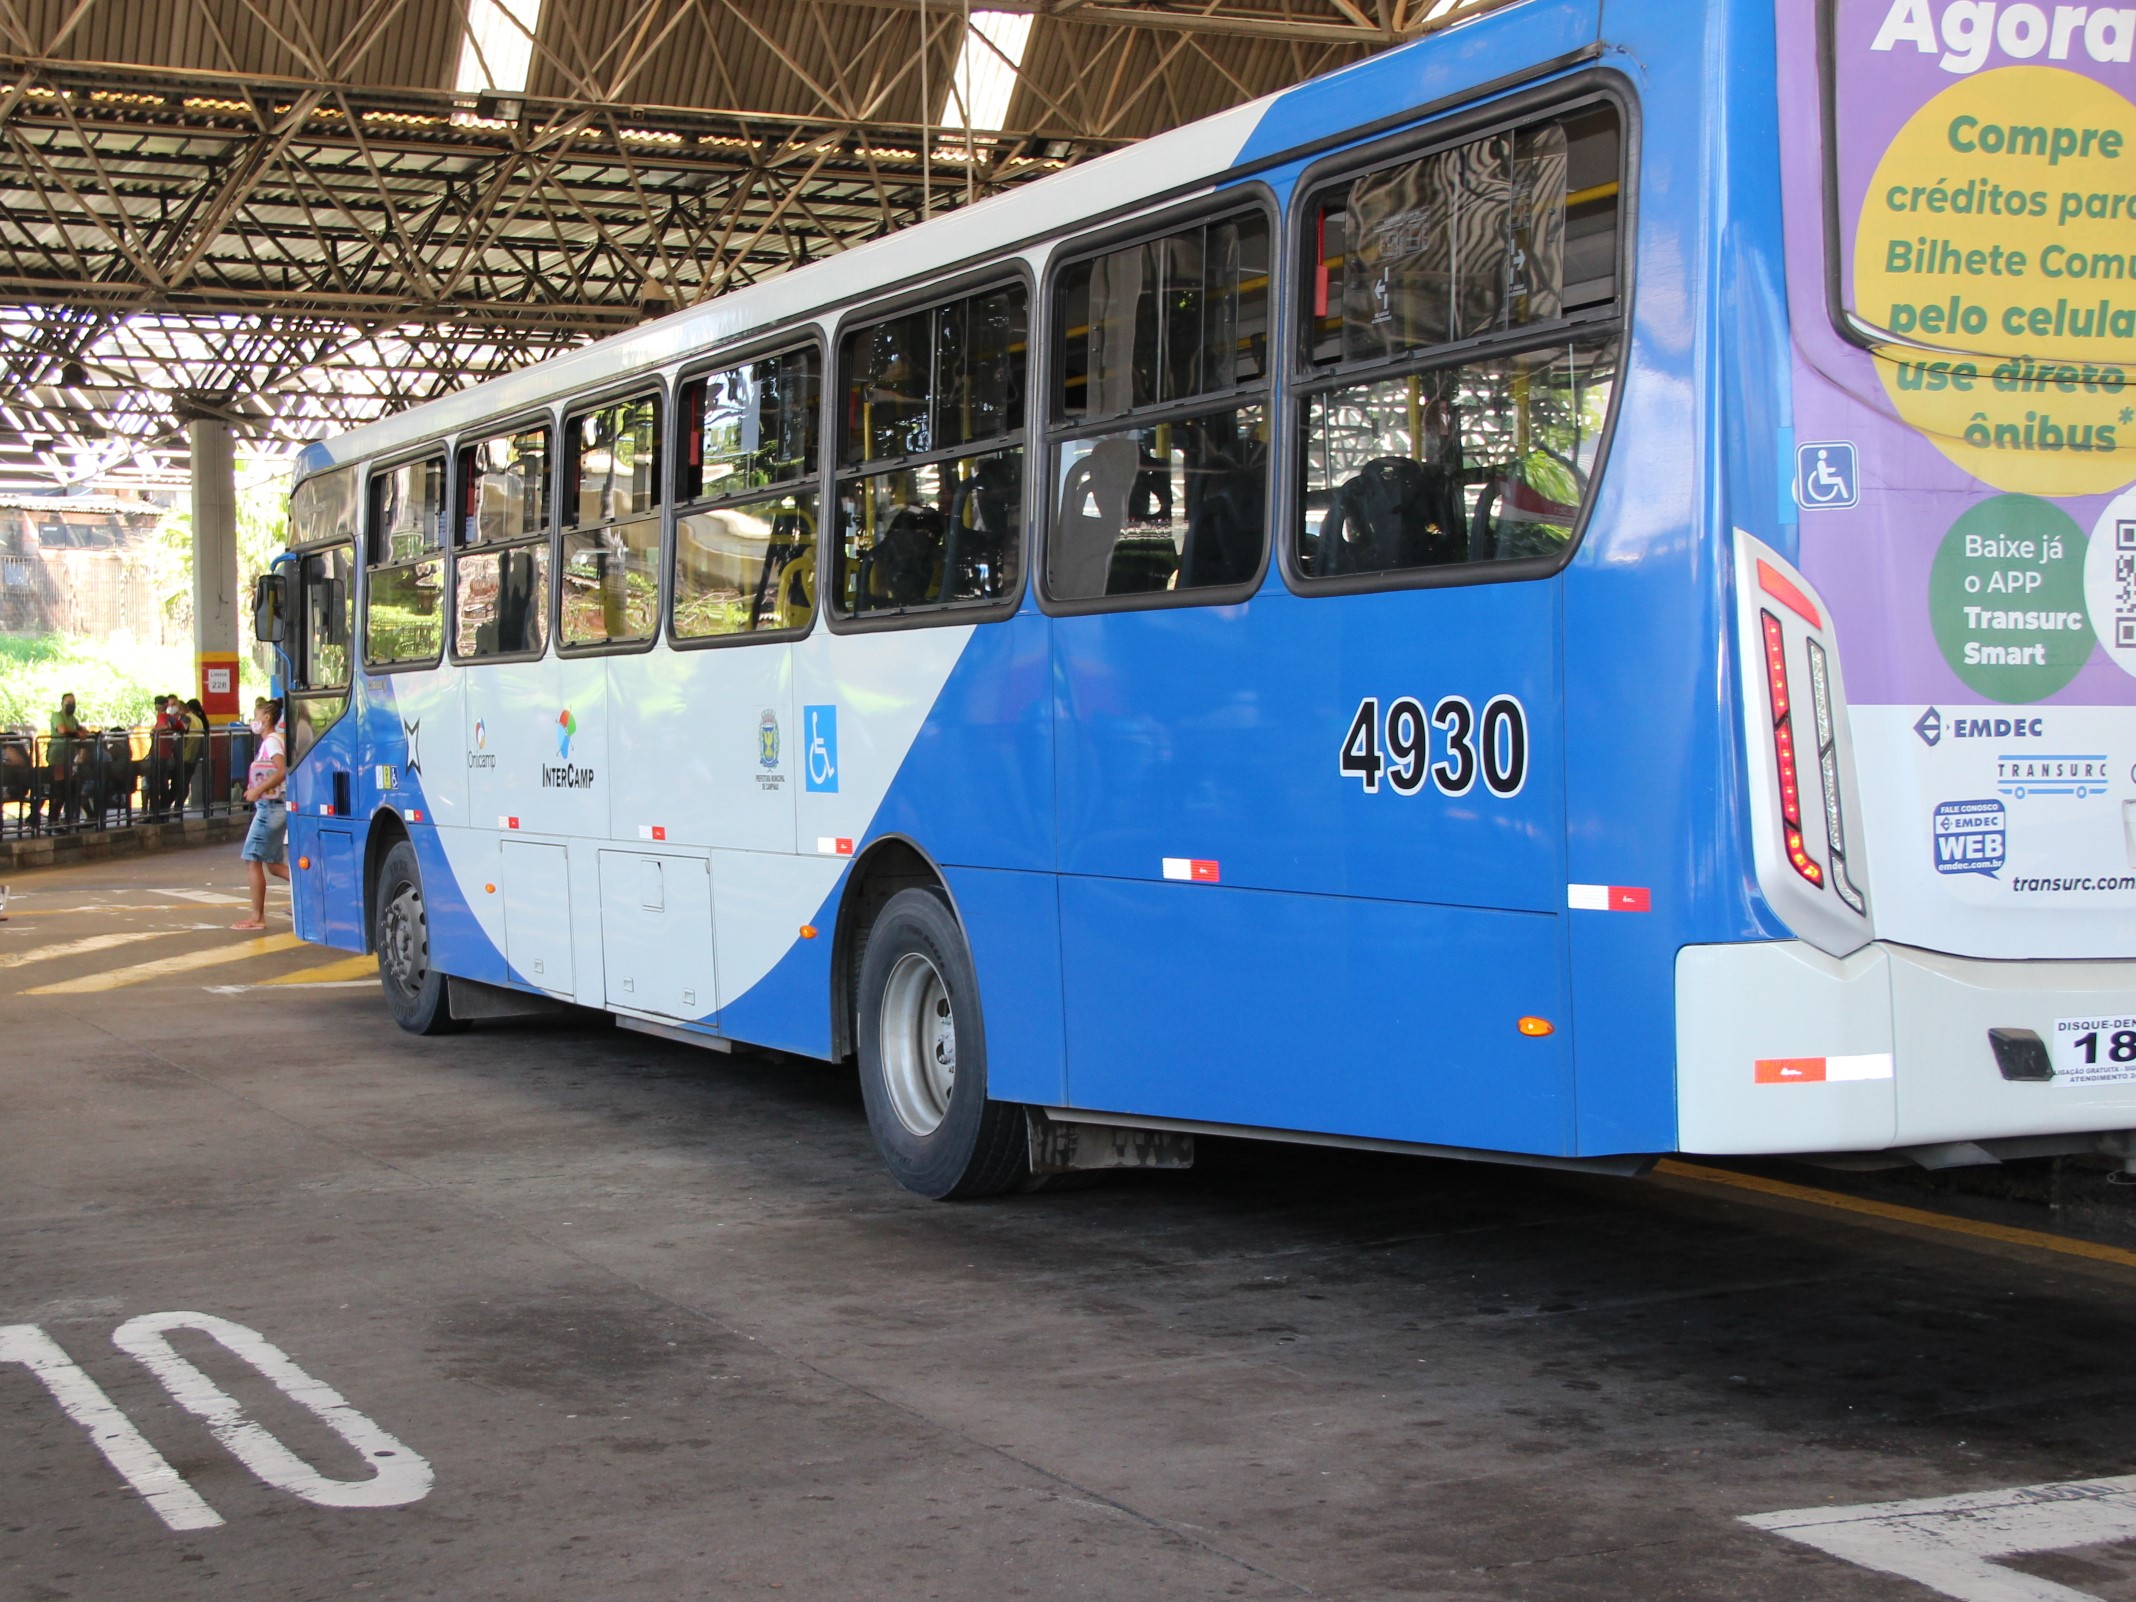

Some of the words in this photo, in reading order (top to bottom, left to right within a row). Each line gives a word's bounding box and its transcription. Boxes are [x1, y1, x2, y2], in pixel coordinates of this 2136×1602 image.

[1870, 0, 2136, 74] Agora
[1948, 115, 2123, 166] Compre
[1886, 177, 2047, 217] créditos
[1885, 236, 2027, 276] Bilhete
[1888, 296, 1988, 335] pelo
[2002, 298, 2136, 338] celula
[1896, 361, 1977, 391] use
[1992, 355, 2126, 394] direto
[1965, 535, 2034, 559] Baixe
[2039, 535, 2063, 565] já
[1964, 576, 1981, 594] o
[1987, 571, 2042, 594] APP
[1964, 607, 2083, 631] Transurc
[1964, 642, 2046, 666] Smart
[1954, 718, 2043, 738] EMDEC
[1340, 694, 1528, 798] 4930
[1998, 763, 2107, 778] TRANSURC
[1961, 804, 1999, 812] CONOSCO
[1955, 817, 1998, 828] EMDEC
[1938, 834, 2003, 861] WEB
[1938, 859, 2003, 871] emdec.com.br
[2069, 1074, 2128, 1082] ATENDIMENTO
[0, 1311, 435, 1530] 10
